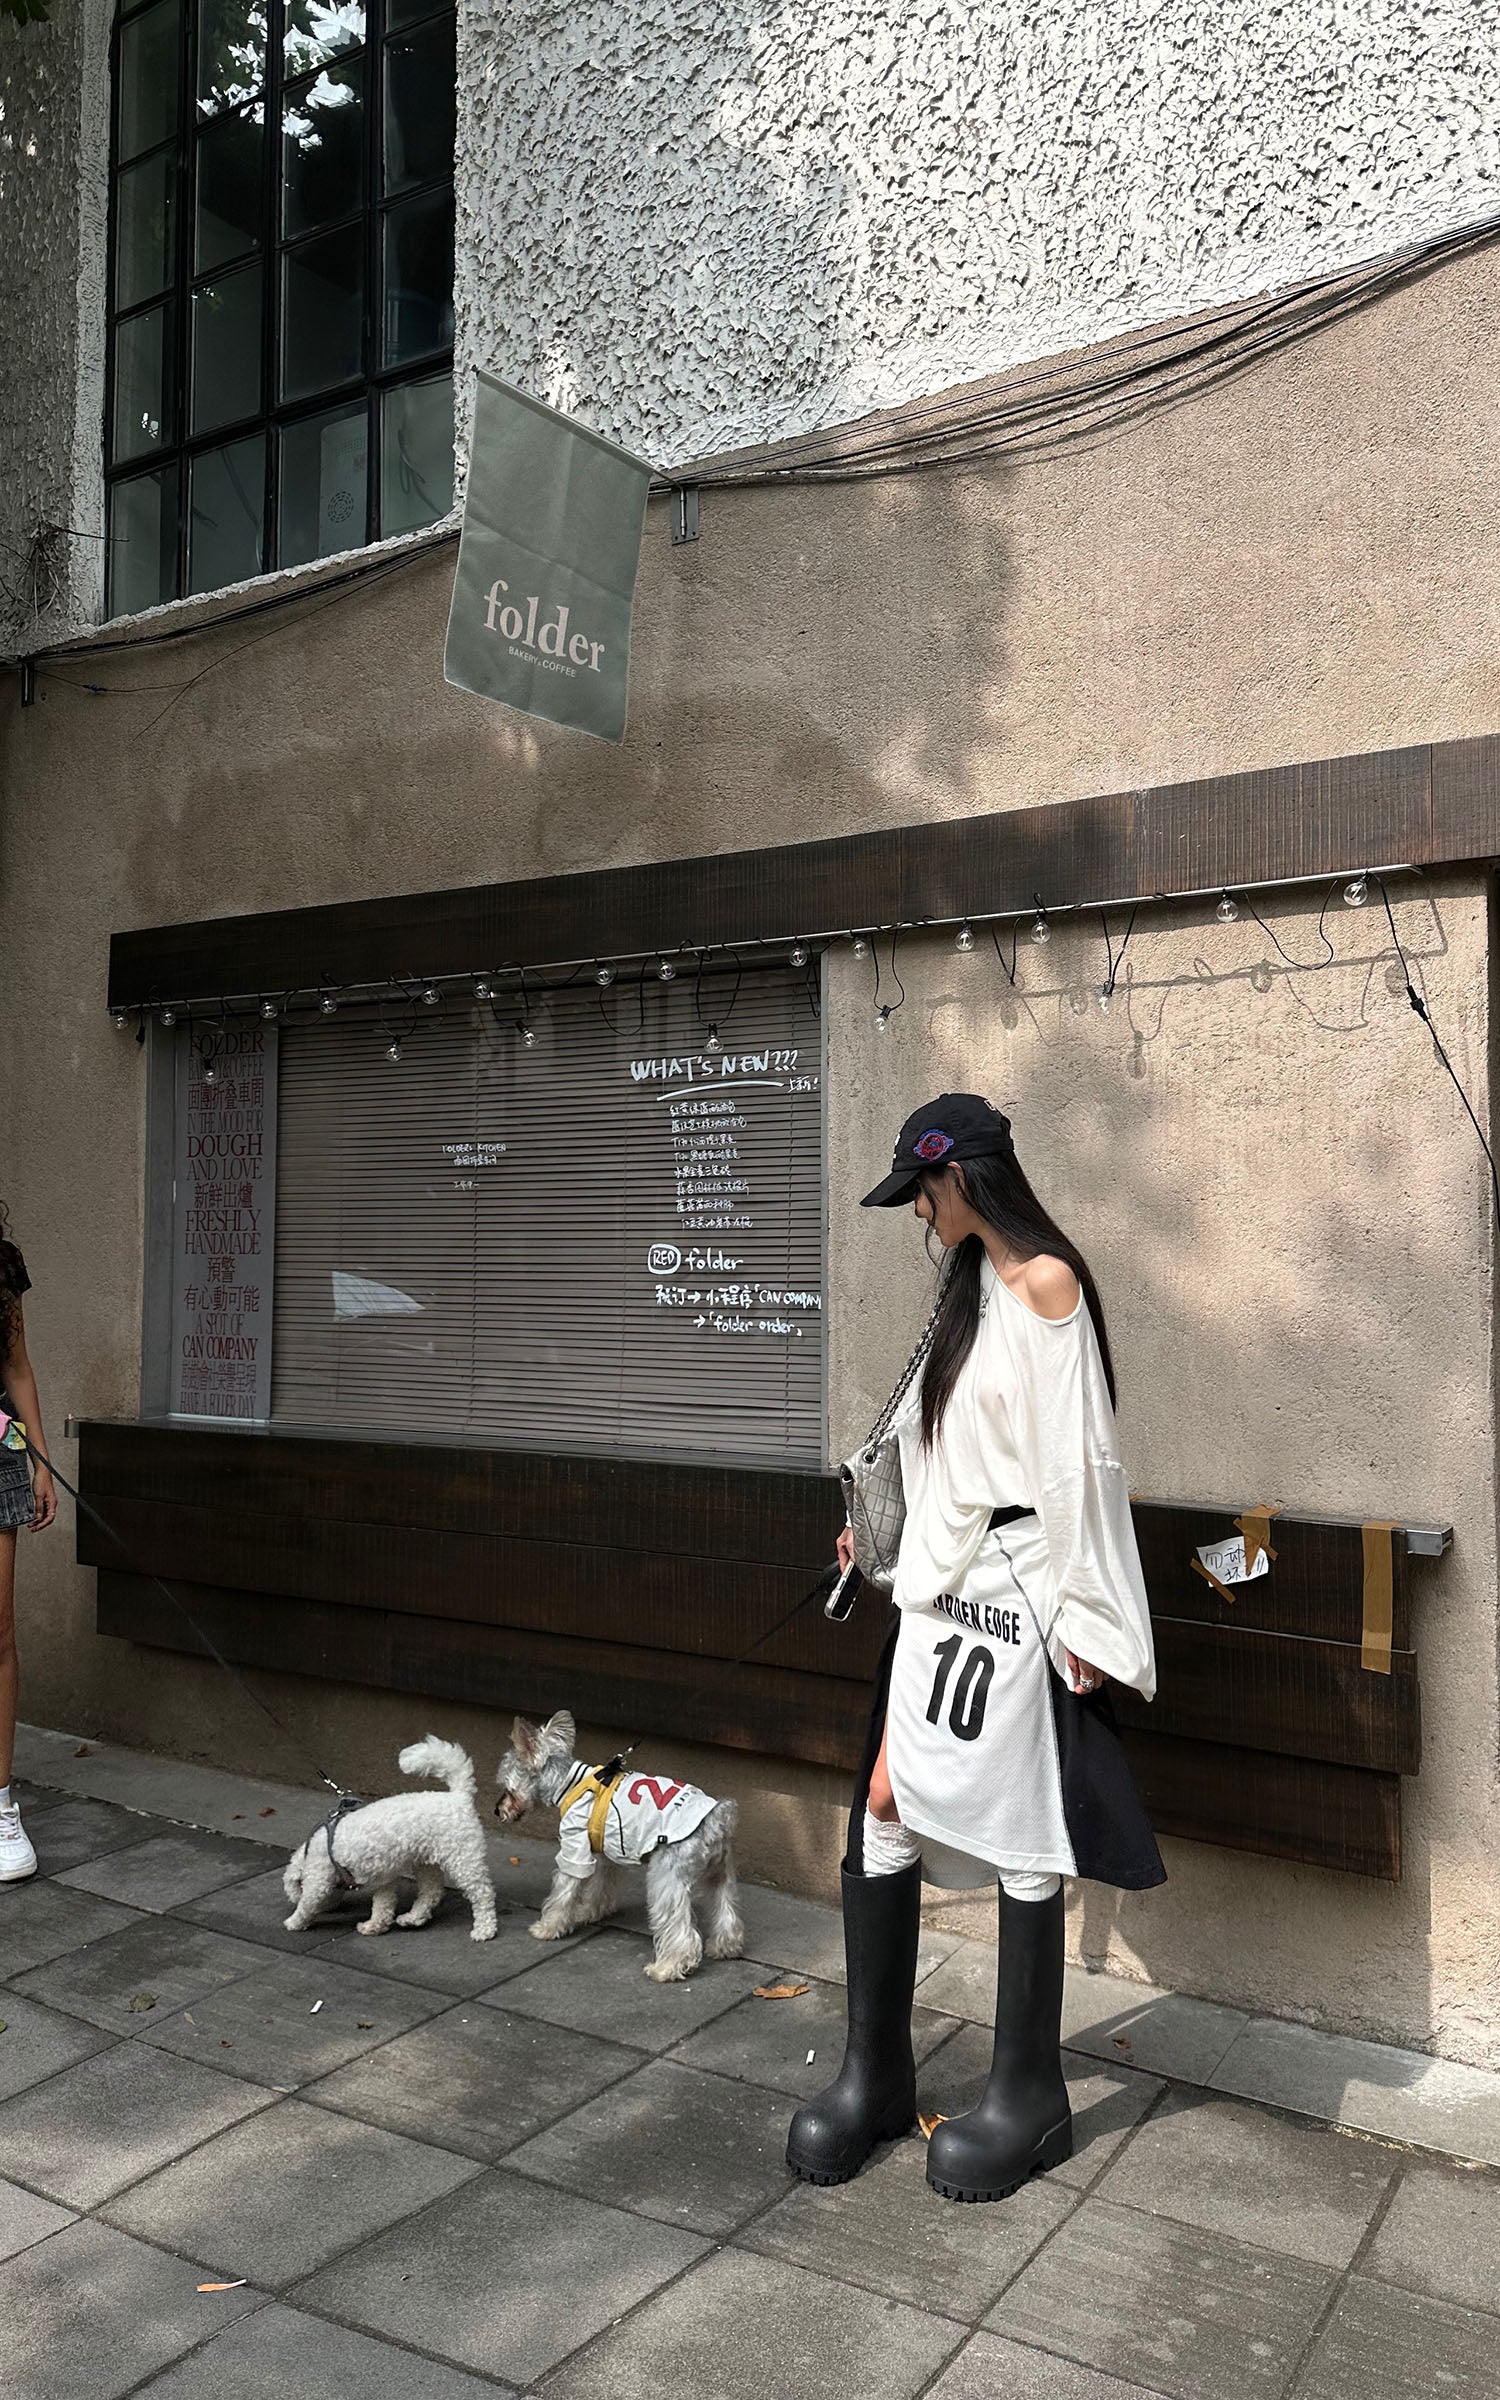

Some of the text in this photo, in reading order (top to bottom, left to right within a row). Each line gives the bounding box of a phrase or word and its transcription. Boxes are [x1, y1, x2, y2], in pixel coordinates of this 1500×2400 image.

[483, 579, 605, 673] folder
[188, 1031, 264, 1057] FOLDER
[187, 1133, 263, 1158] DOUGH
[187, 1157, 263, 1181] AND LOVE
[185, 1209, 262, 1232] FRESHLY
[185, 1232, 261, 1255] HANDMADE
[685, 1247, 744, 1272] folder
[184, 1284, 260, 1313] 有心動可能
[182, 1335, 259, 1361] CAN COMPANY
[933, 1593, 1020, 1646] ARDEN EDGE
[925, 1633, 995, 1742] 10
